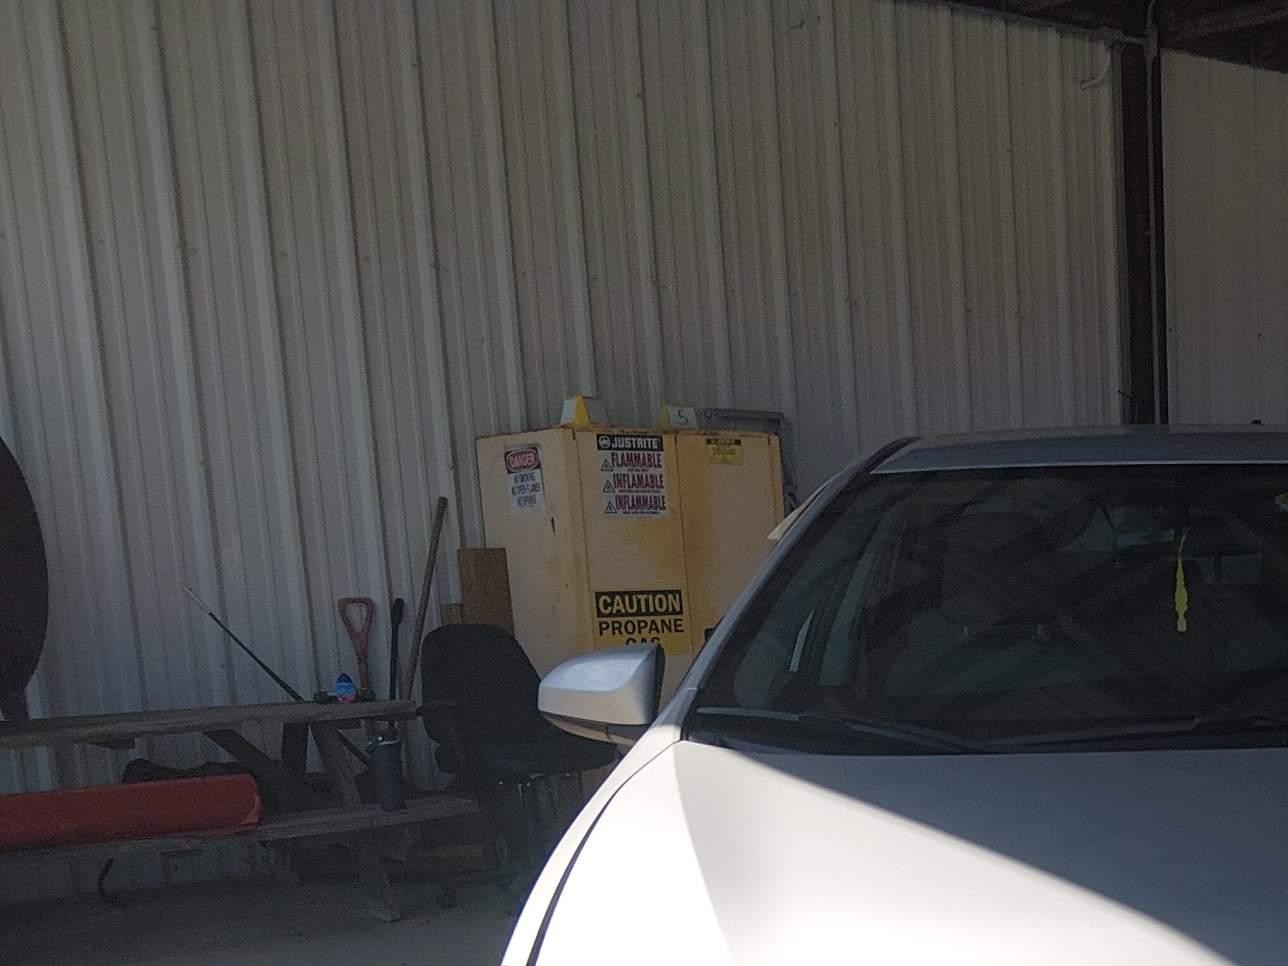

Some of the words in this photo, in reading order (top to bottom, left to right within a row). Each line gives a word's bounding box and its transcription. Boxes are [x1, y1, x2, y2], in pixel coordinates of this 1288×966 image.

[677, 409, 689, 425] 5
[610, 437, 658, 449] JUSTRITE
[611, 452, 662, 469] FLAMMABLE
[598, 593, 681, 614] CAUTION
[598, 618, 684, 636] PROPANE
